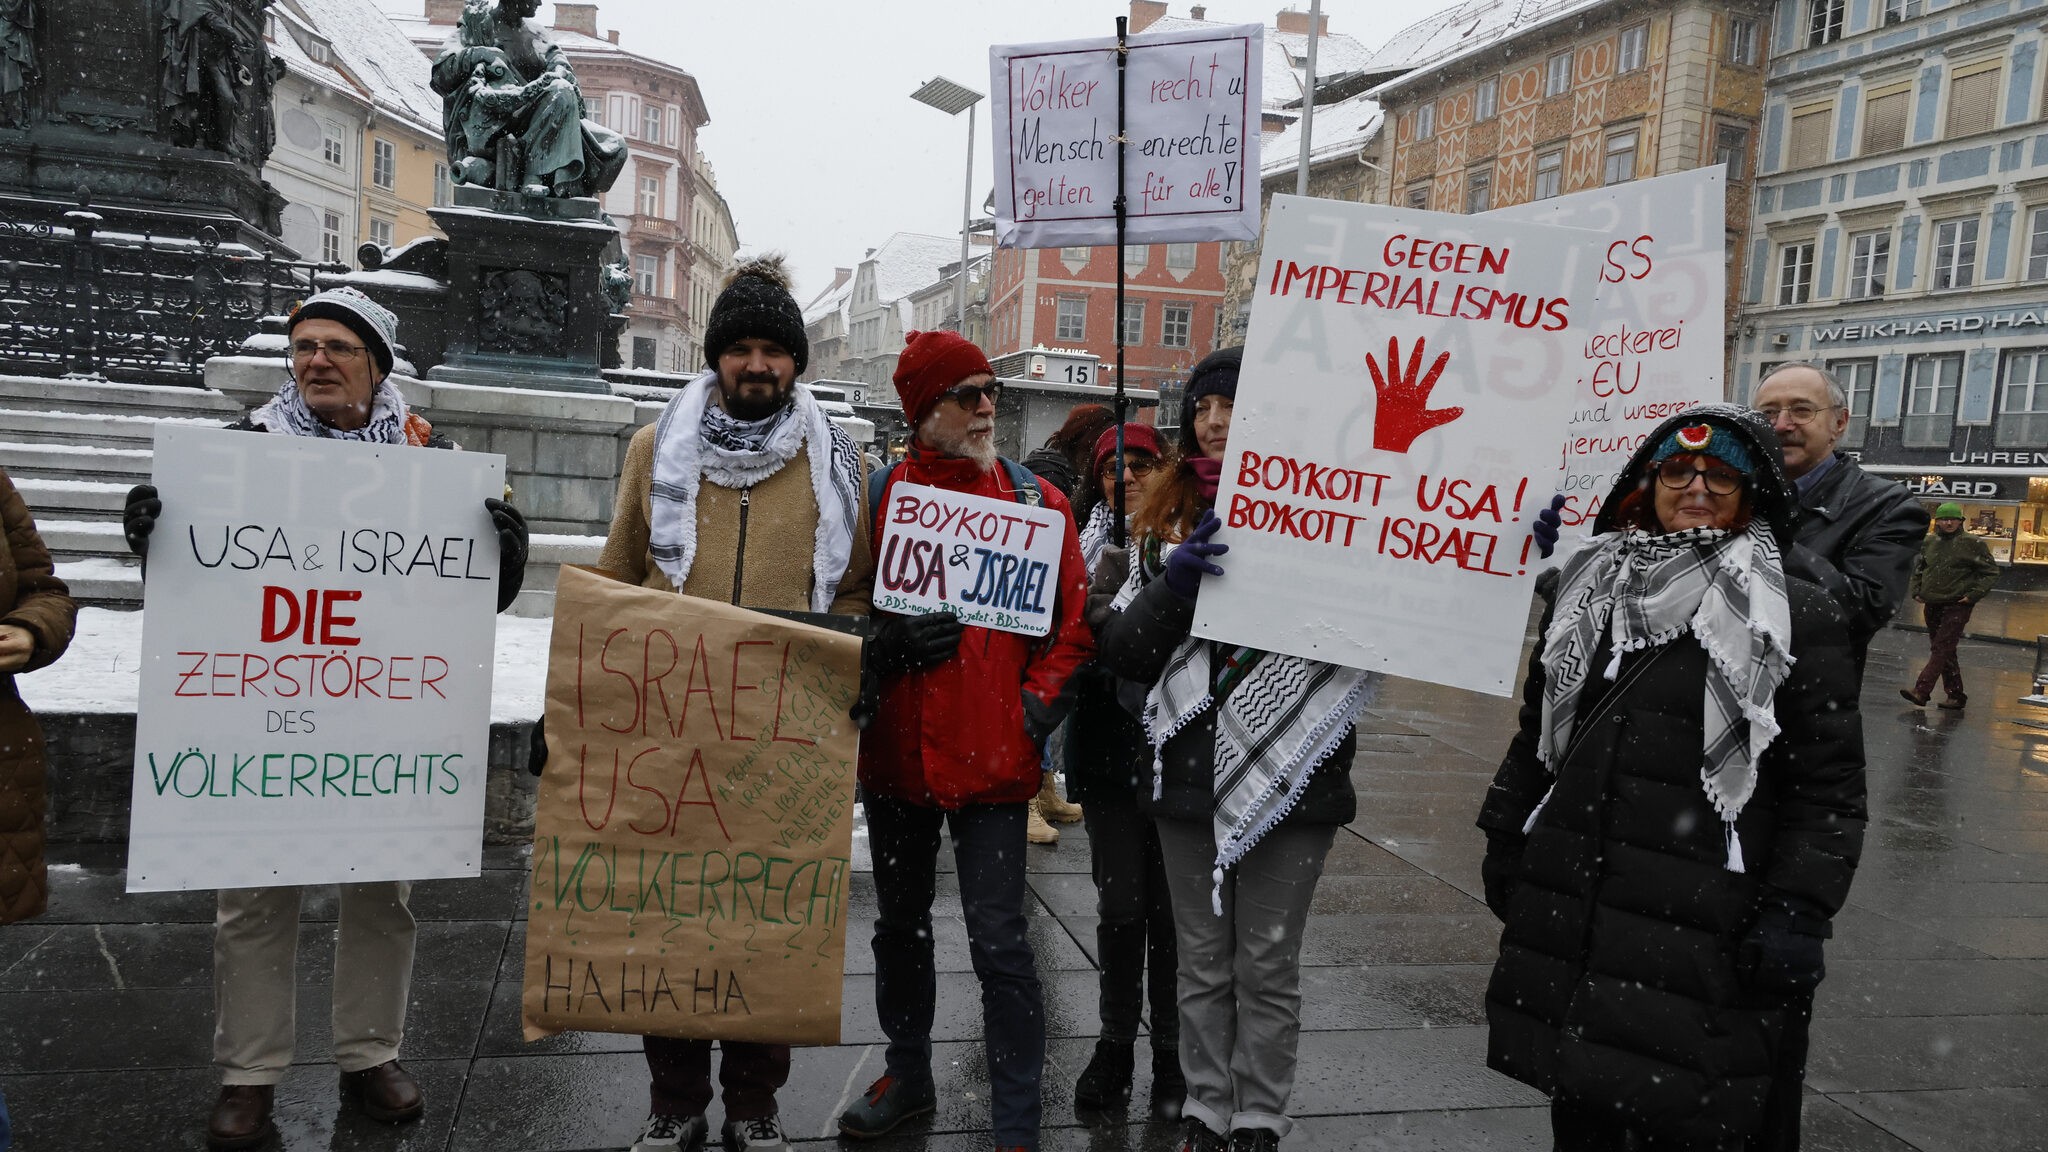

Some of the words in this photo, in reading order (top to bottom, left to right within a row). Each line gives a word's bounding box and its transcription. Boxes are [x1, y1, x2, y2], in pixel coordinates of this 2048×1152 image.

[1021, 63, 1099, 112] Völker
[1150, 52, 1219, 103] recht
[1023, 174, 1094, 218] gelten
[1140, 171, 1174, 216] für
[1382, 233, 1511, 276] GEGEN
[1269, 258, 1570, 332] IMPERIALISMUS
[853, 389, 861, 402] 8
[1064, 364, 1088, 384] 15
[1592, 361, 1641, 398] EU
[1237, 450, 1392, 502] BOYKOTT
[891, 495, 1050, 551] BOYKOTT
[1226, 492, 1367, 548] BOYKOTT
[189, 524, 297, 571] USA
[302, 544, 324, 571] &
[339, 529, 491, 581] ISRAEL
[882, 533, 947, 601] USA
[948, 543, 970, 572] &
[260, 584, 363, 647] DIE
[174, 649, 449, 700] ZERSTÖRER
[577, 622, 815, 747] ISRAEL
[266, 710, 316, 734] DES
[148, 747, 464, 799] VÖLKERRECHTS
[579, 743, 732, 842] USA
[761, 753, 830, 825] LIBANON
[553, 835, 850, 929] VÖLKERRECHT
